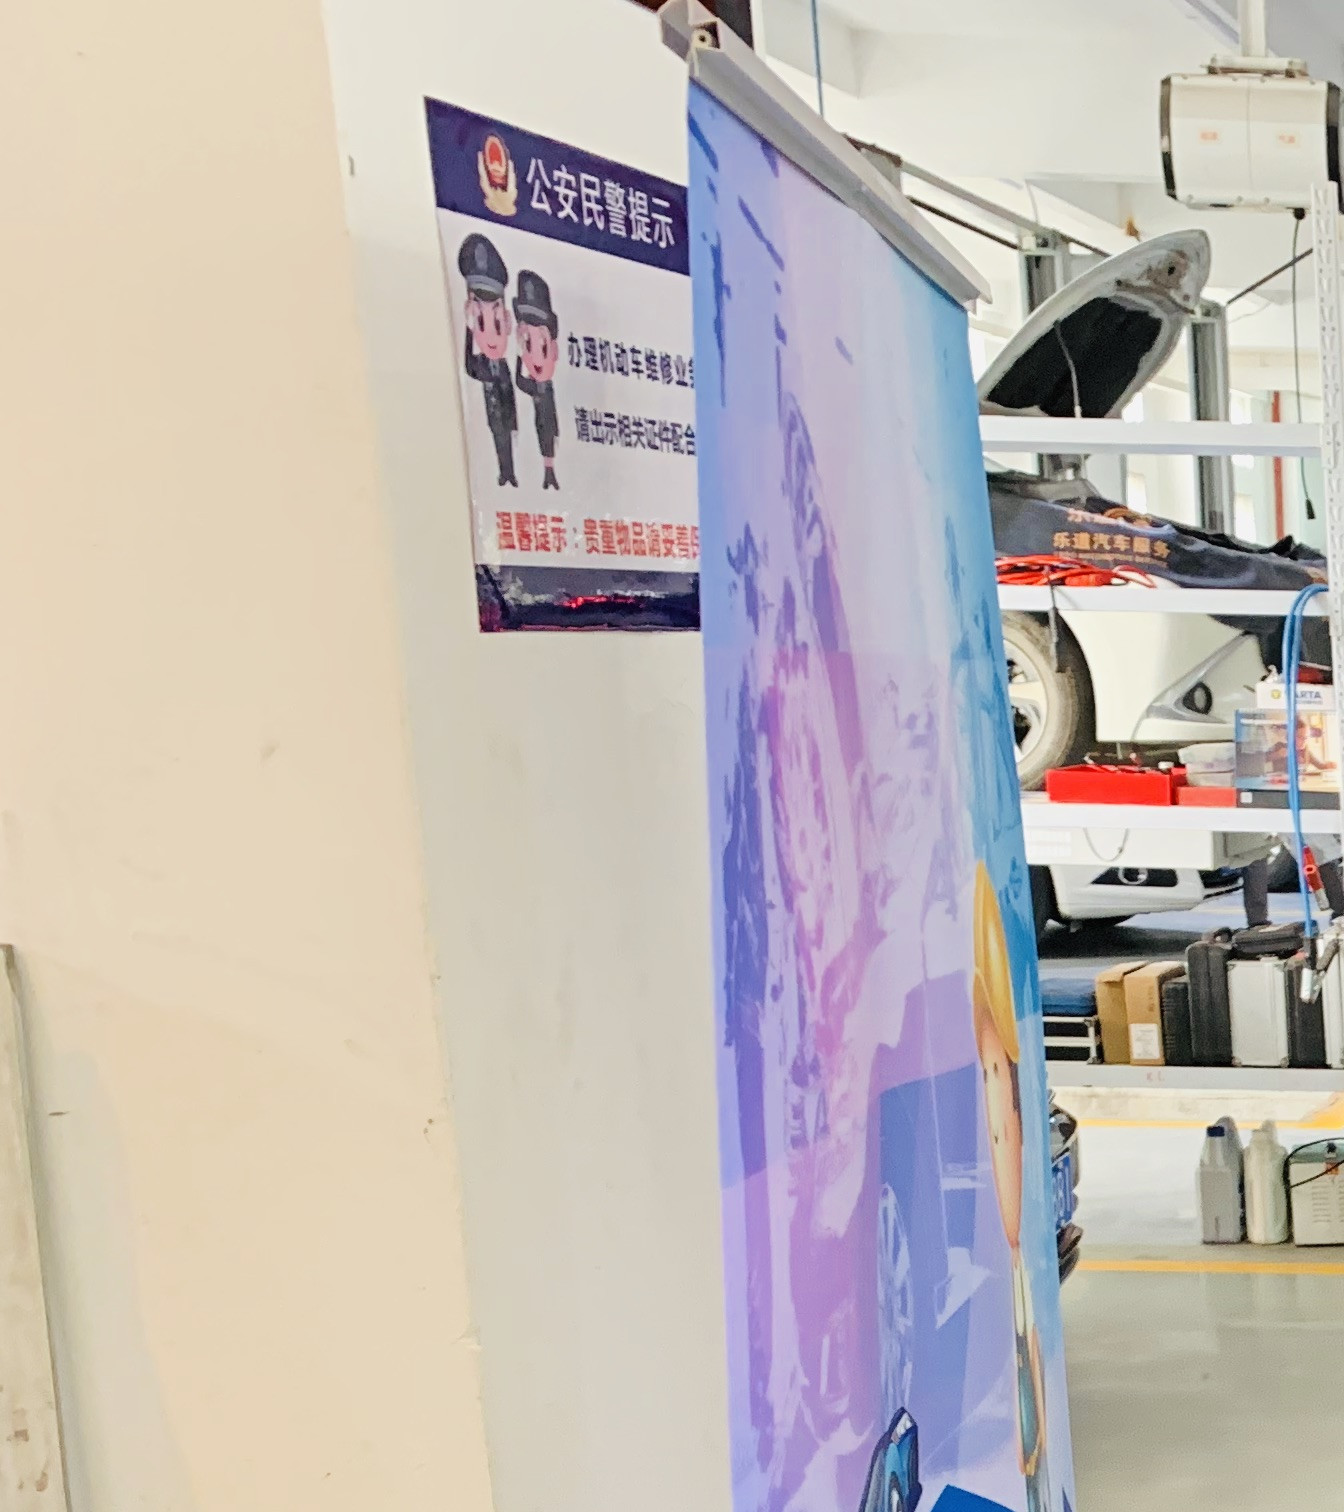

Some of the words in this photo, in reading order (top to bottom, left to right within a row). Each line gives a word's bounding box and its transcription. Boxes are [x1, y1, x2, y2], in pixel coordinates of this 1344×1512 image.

[525, 156, 675, 249] 公安民警提示
